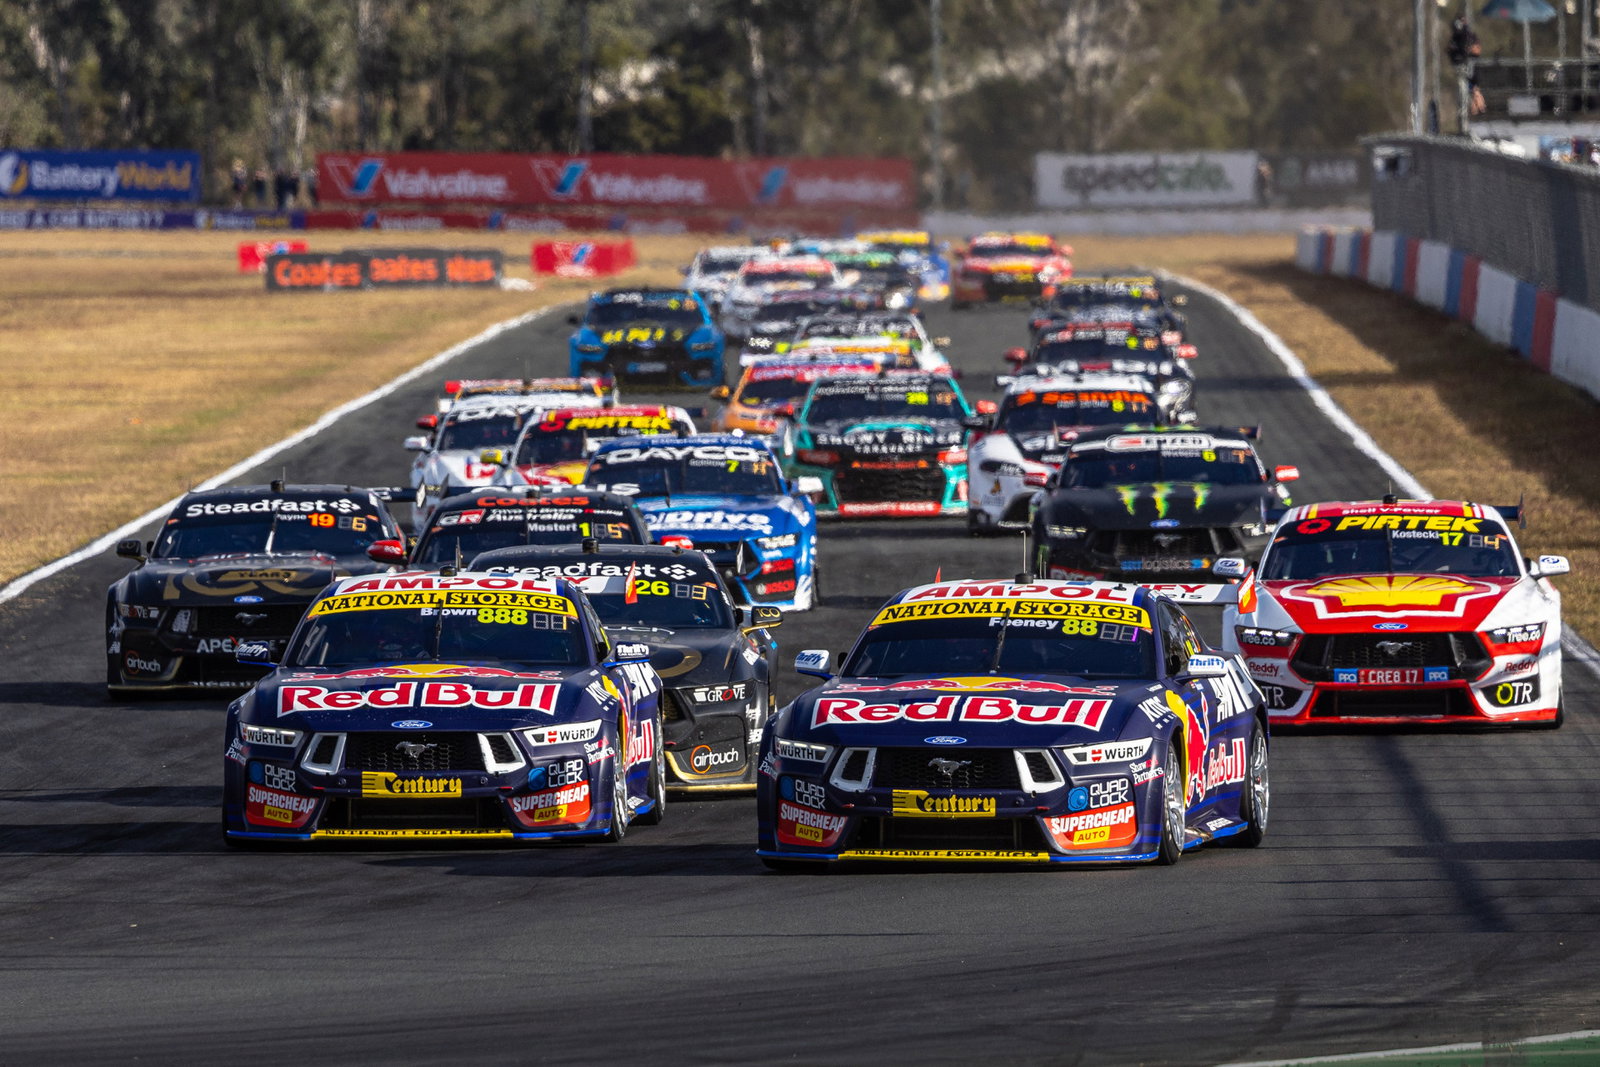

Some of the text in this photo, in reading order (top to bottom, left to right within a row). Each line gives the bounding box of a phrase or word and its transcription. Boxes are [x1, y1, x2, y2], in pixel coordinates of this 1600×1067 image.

[726, 459, 740, 473] 7
[186, 499, 327, 518] Steadfast
[308, 513, 336, 528] 19
[1335, 516, 1483, 533] PIRTEK
[527, 522, 577, 533] Mostert
[579, 522, 590, 537] 1
[1392, 530, 1439, 539] Kostecki
[1440, 532, 1464, 546] 17
[341, 578, 551, 592] AMPOL
[635, 580, 670, 596] 26
[909, 585, 1128, 601] AMPOL
[318, 592, 563, 613] NATIONAL STORAGE
[420, 607, 477, 617] Brown
[477, 609, 528, 625] 888
[882, 601, 1138, 622] NATIONAL STORAGE
[988, 617, 1059, 630] Feeney
[1062, 620, 1098, 636] 88
[1189, 658, 1225, 668] Thrifty
[1249, 661, 1279, 677] Reddy
[1505, 660, 1536, 673] Reddy
[1368, 670, 1418, 684] CRE8 17
[277, 682, 561, 718] Red Bull
[707, 688, 746, 702] GROVE
[1496, 682, 1533, 705] OTR
[810, 695, 1113, 732] Red Bull
[560, 727, 595, 741] WÜRTH
[693, 747, 738, 767] airtouch
[1105, 745, 1143, 760] WÜRTH
[265, 763, 296, 781] QUAD
[549, 758, 583, 775] QUAD
[265, 776, 296, 792] LOCK
[549, 770, 583, 788] LOCK
[1090, 777, 1129, 797] QUAD
[795, 779, 825, 798] QUAD
[248, 787, 316, 814] SUPERCHEAP
[512, 784, 589, 813] SUPERCHEAP
[795, 792, 826, 810] LOCK
[1090, 789, 1128, 809] LOCK
[266, 808, 290, 820] AUTO
[537, 807, 564, 820] AUTO
[781, 803, 846, 832] SUPERCHEAP
[1051, 804, 1135, 834] SUPERCHEAP
[798, 826, 820, 839] AUTO
[1077, 829, 1106, 842] AUTO
